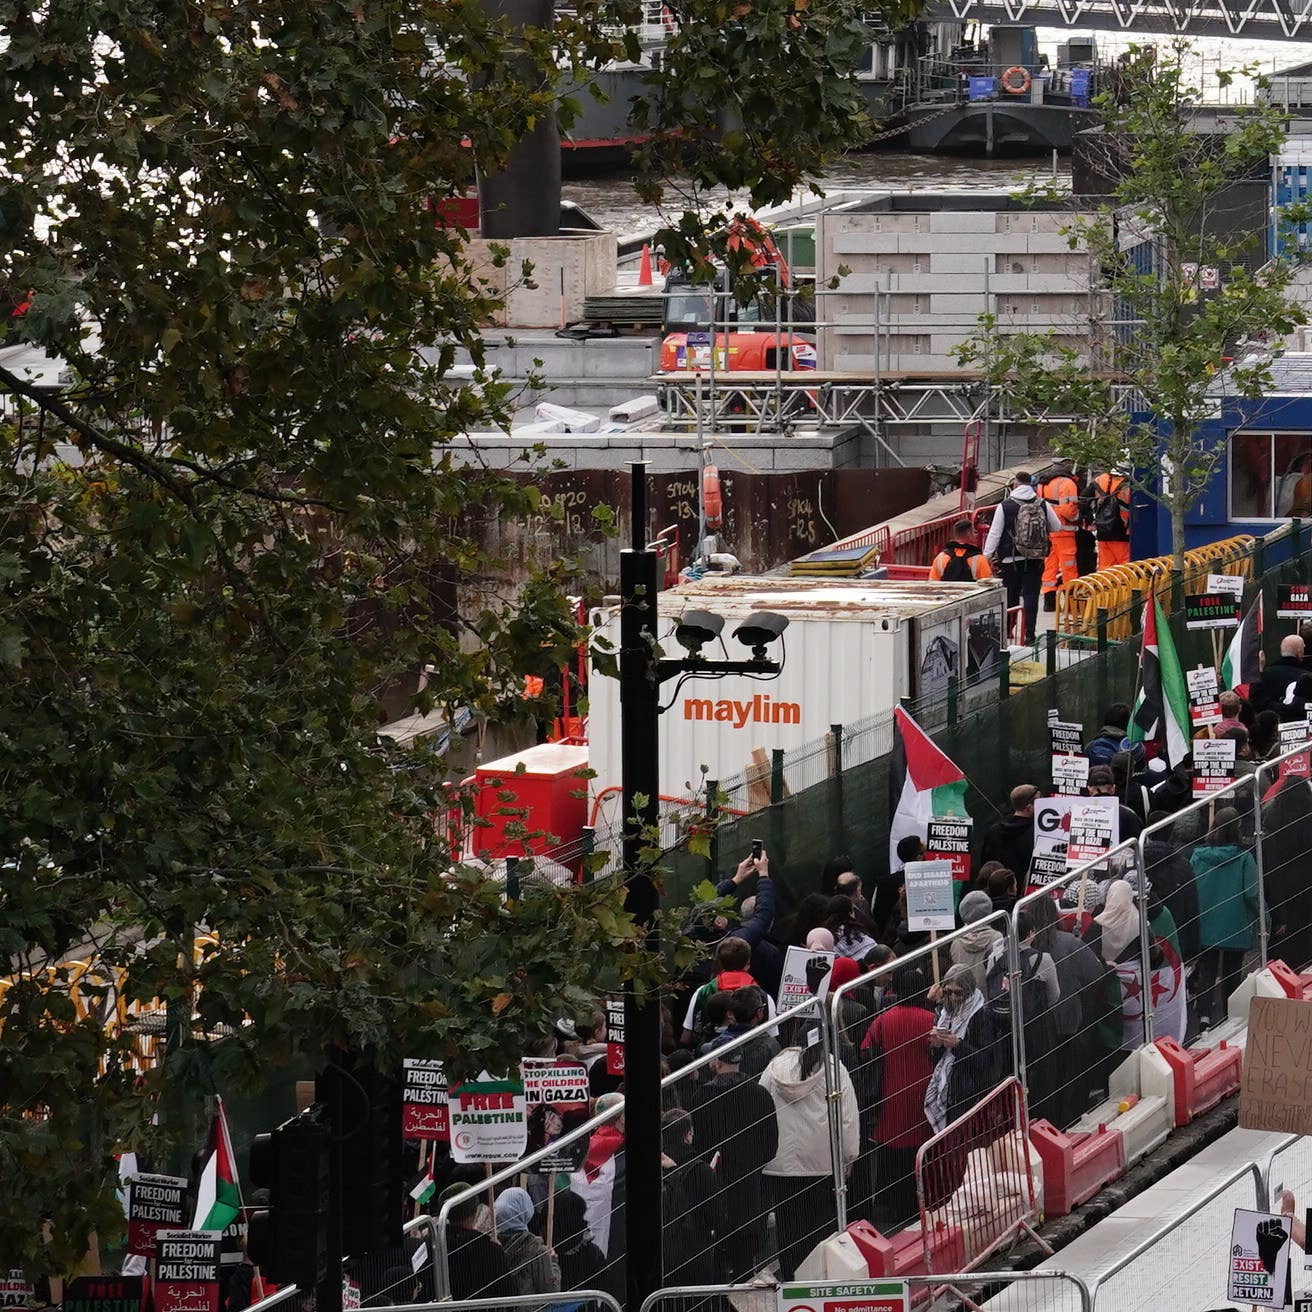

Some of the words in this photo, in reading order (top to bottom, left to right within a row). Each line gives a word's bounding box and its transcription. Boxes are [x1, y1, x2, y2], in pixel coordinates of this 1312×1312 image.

[683, 694, 801, 728] maylim
[931, 825, 967, 836] FREEDOM
[929, 840, 969, 852] PALESTINE
[547, 1069, 584, 1077] KILLING
[525, 1091, 541, 1102] IN
[545, 1088, 584, 1102] GAZA
[459, 1093, 514, 1111] FREE
[452, 1112, 523, 1125] PALESTINE
[135, 1186, 181, 1203] FREEDOM
[132, 1205, 182, 1223] PALESTINE
[162, 1243, 214, 1259] FREEDOM
[1233, 1258, 1263, 1270] EXIST.
[158, 1265, 216, 1280] PALESTINE
[1233, 1272, 1268, 1285] RESIST.
[810, 1288, 832, 1297] SITE
[836, 1286, 875, 1296] SAFETY
[1233, 1286, 1273, 1299] RETURN.
